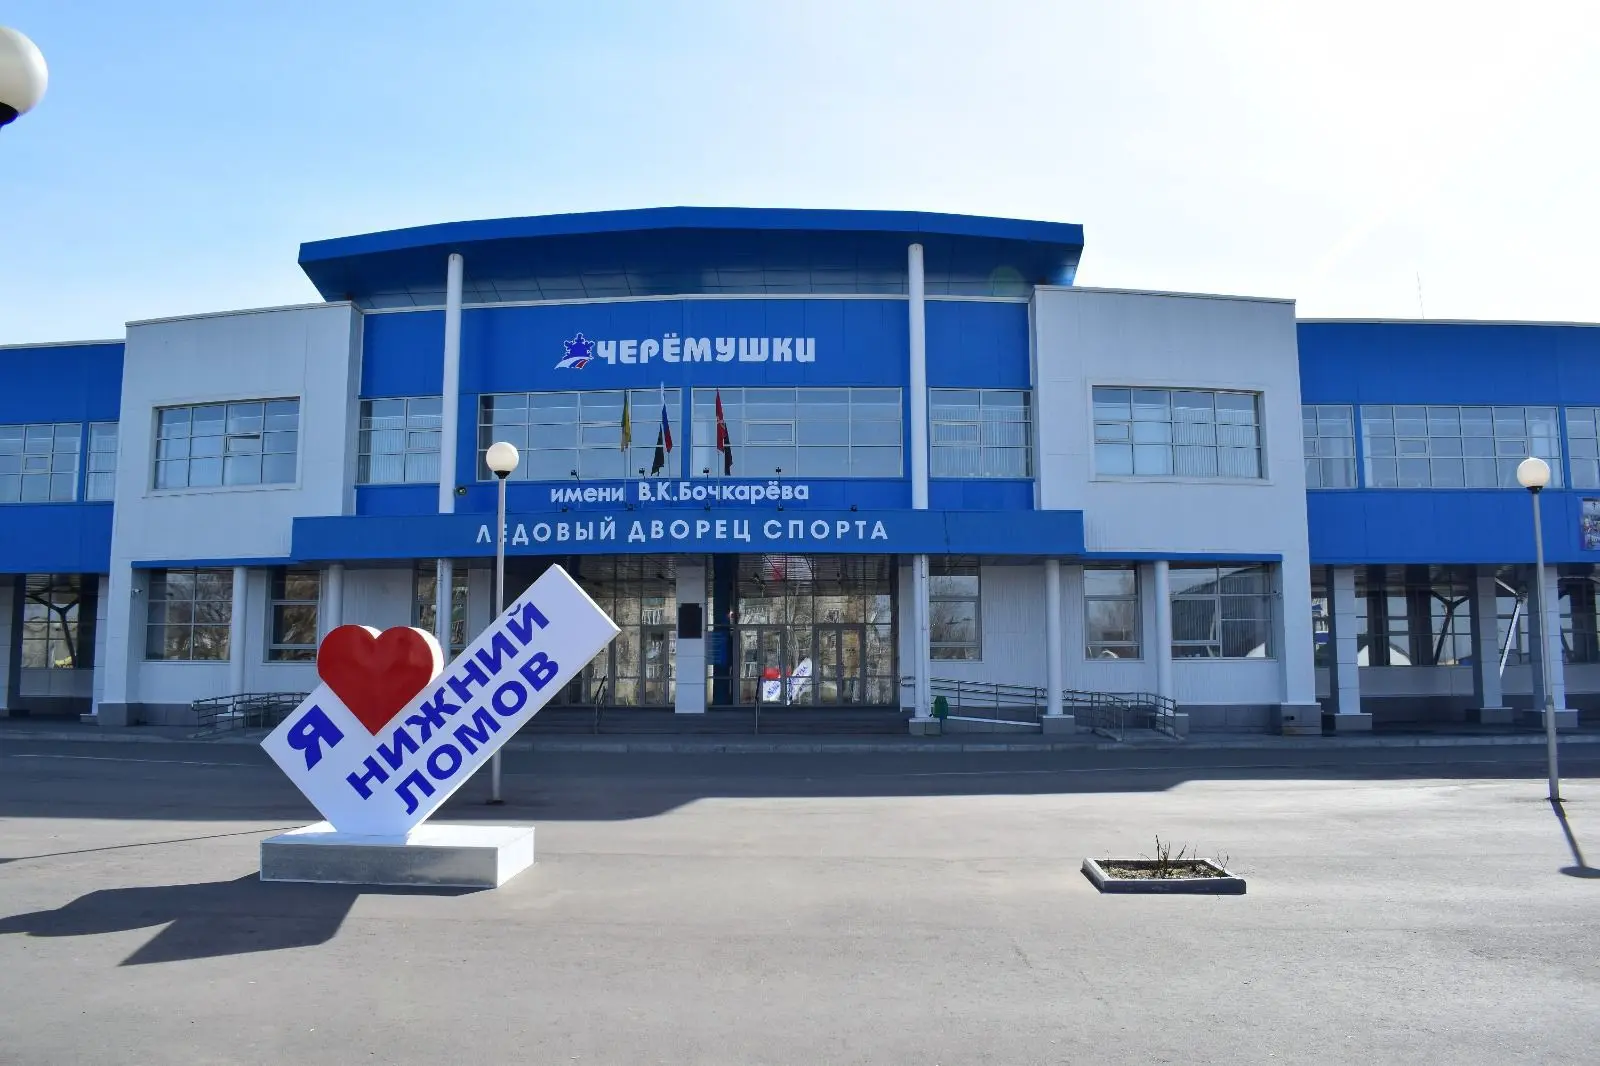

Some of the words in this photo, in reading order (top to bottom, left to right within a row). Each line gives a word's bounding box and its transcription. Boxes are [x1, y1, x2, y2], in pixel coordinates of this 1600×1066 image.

[597, 333, 816, 365] ЧЕРЁМУШКИ
[551, 487, 624, 503] имени
[628, 519, 751, 543] ДВОРЕЦ
[763, 519, 889, 540] СПОРТА
[346, 601, 550, 801] НИЖНИЙ
[287, 704, 345, 771] Я
[394, 651, 559, 815] ЛОМОВ
